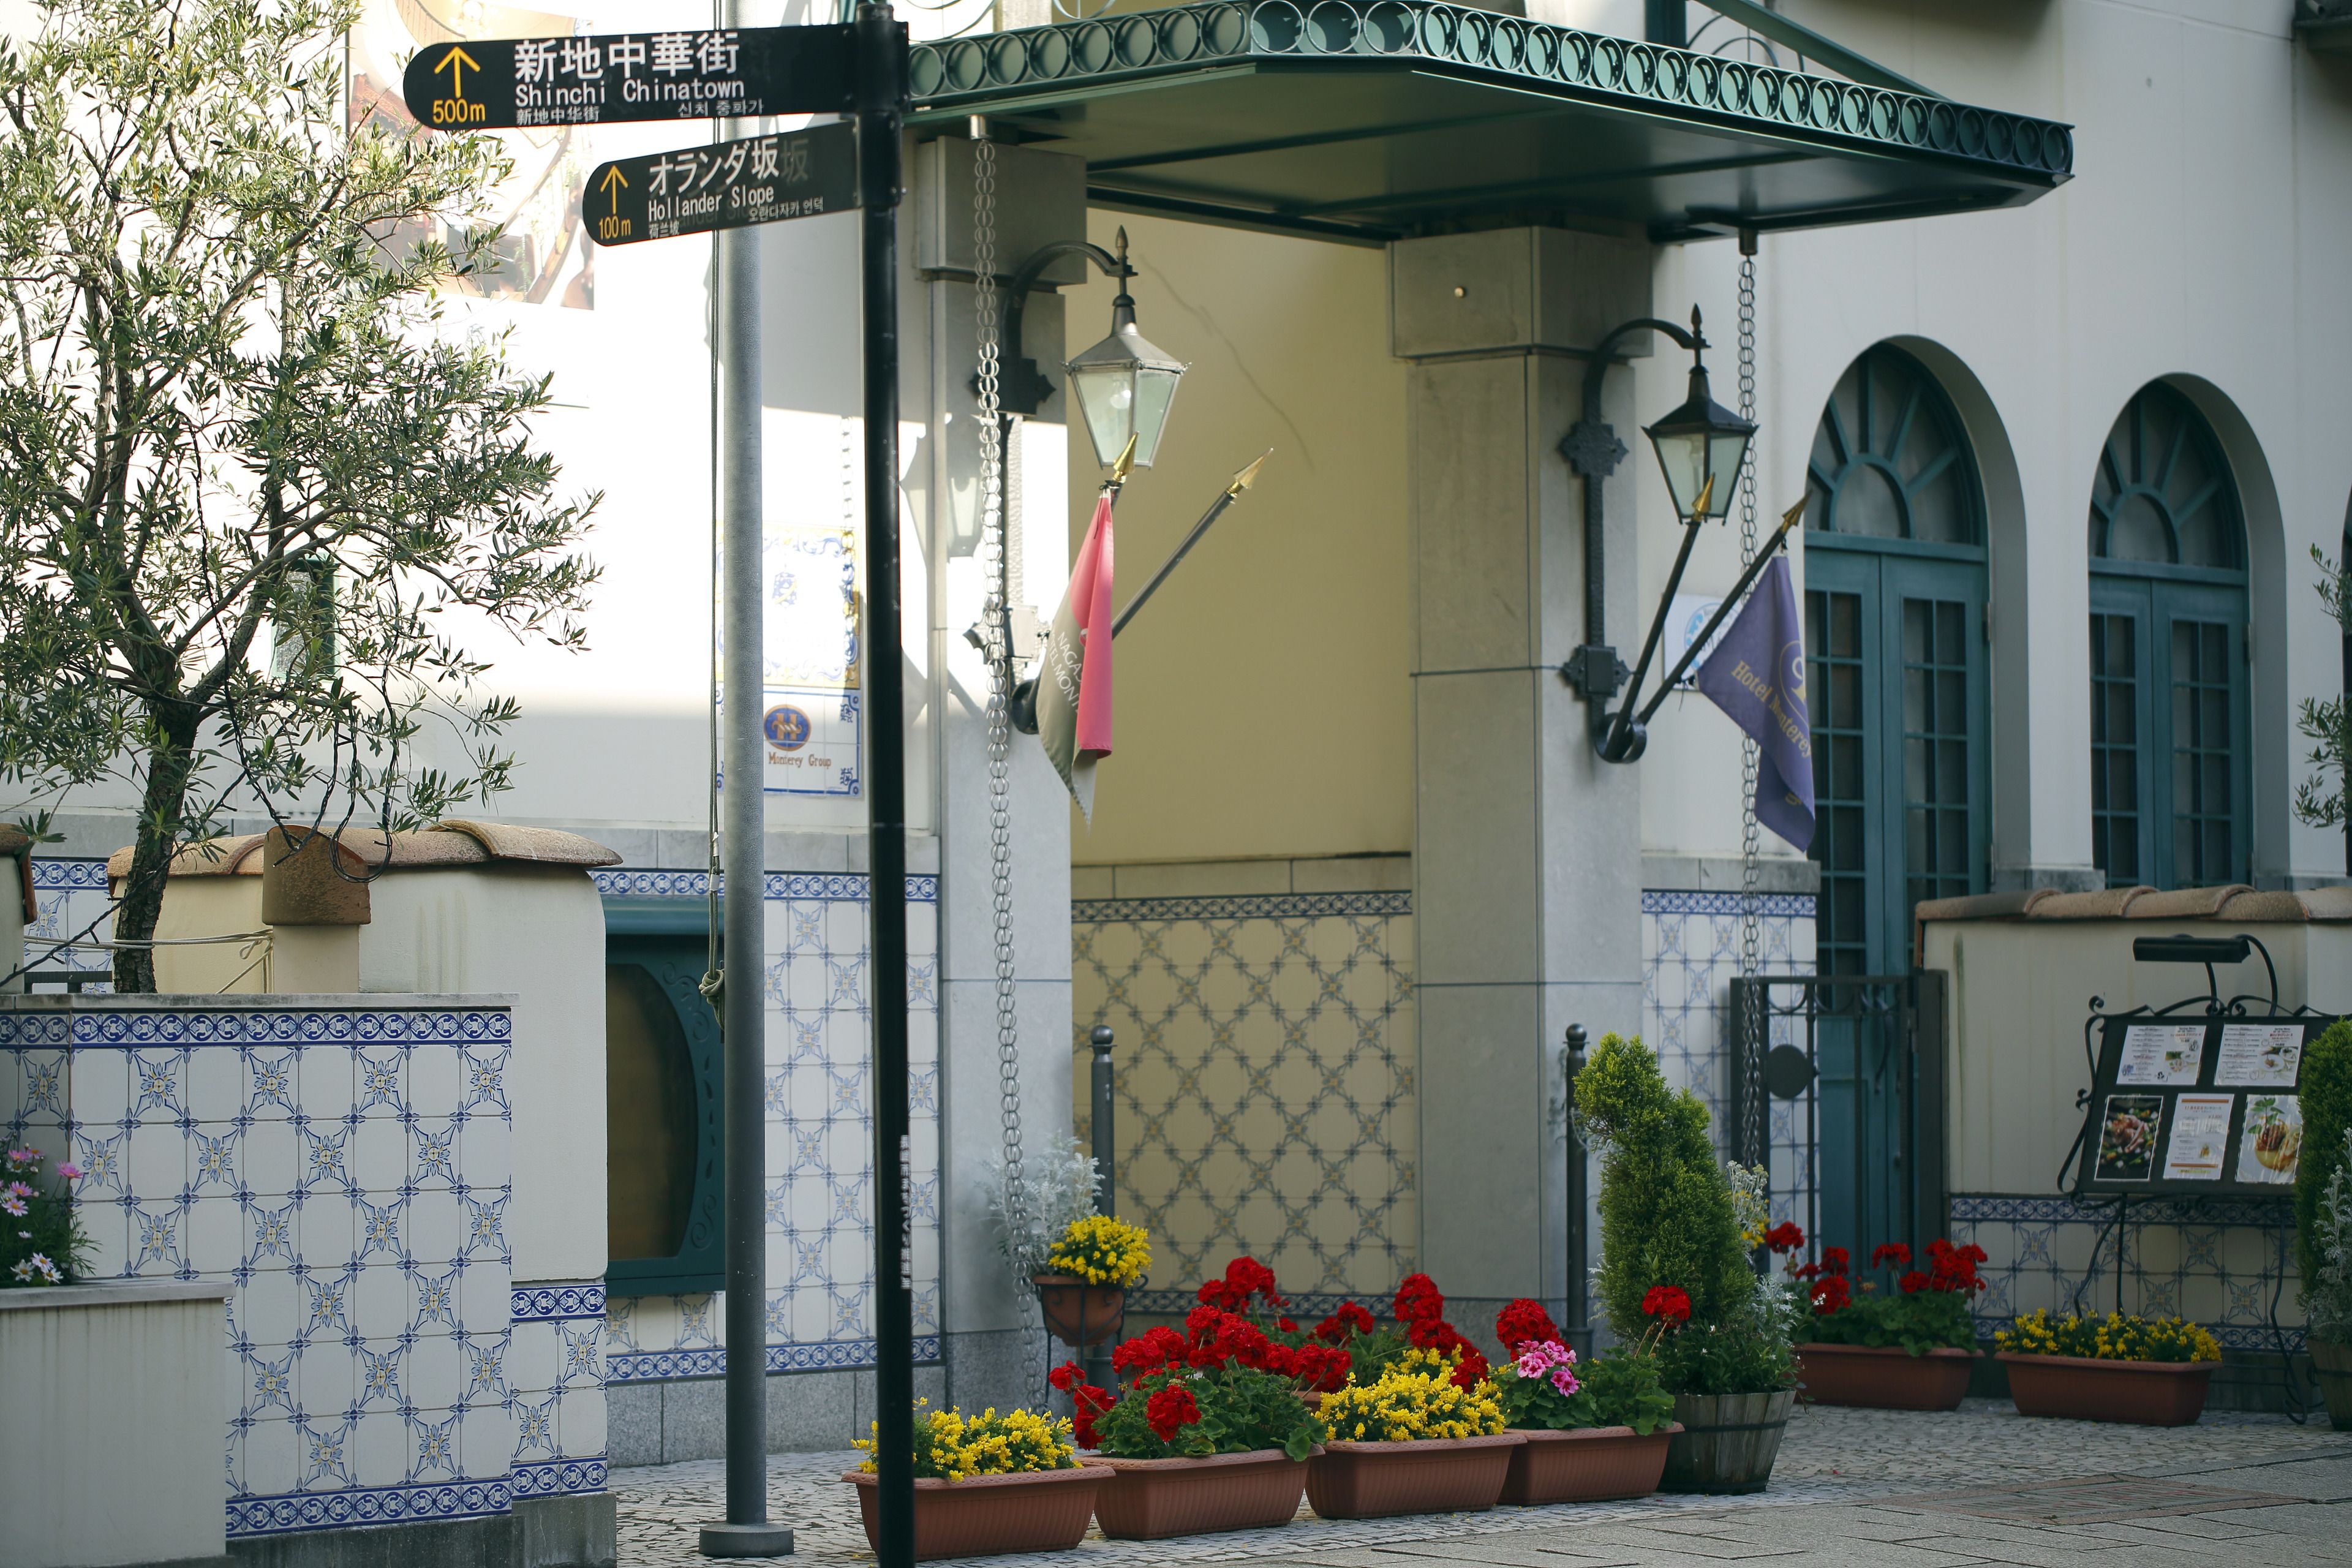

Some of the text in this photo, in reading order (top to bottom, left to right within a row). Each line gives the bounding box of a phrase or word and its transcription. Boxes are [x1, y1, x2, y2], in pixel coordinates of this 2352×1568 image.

[514, 32, 740, 83] 新地中華街
[515, 77, 745, 107] Shinchi Chinatown
[432, 98, 486, 124] 500m
[515, 105, 600, 126] 新地中华街
[678, 98, 764, 118] 신치 중화가
[649, 138, 779, 195] オランダ坂
[648, 193, 722, 222] Hollander
[731, 183, 774, 210] Slope
[802, 195, 824, 215] 언덕
[648, 219, 680, 239] 荷兰坡
[1732, 660, 1773, 703] Hotel
[1769, 693, 1812, 758] Monterey
[767, 751, 832, 770] Monterey Group
